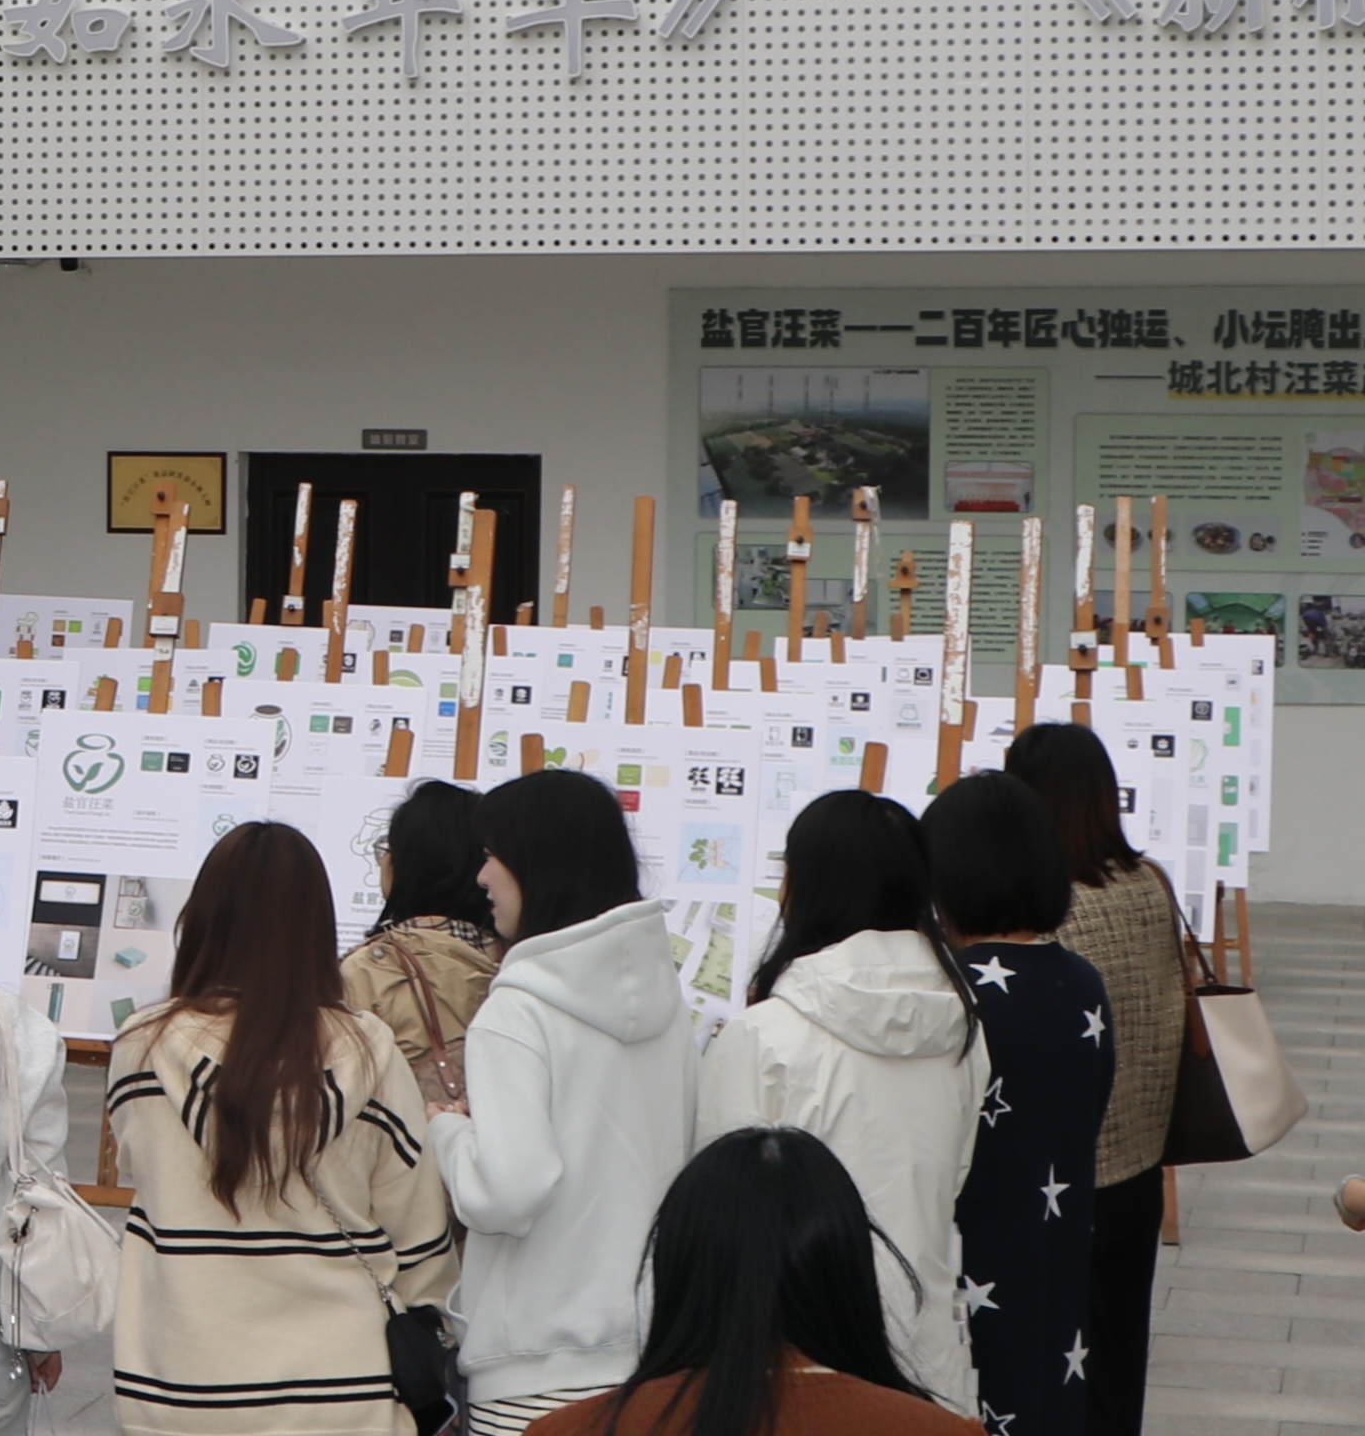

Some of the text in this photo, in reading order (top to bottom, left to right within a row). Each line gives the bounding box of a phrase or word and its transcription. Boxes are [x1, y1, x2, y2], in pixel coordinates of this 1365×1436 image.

[1094, 360, 1365, 396] ——城北村汪菜
[351, 891, 394, 906] 盐官
